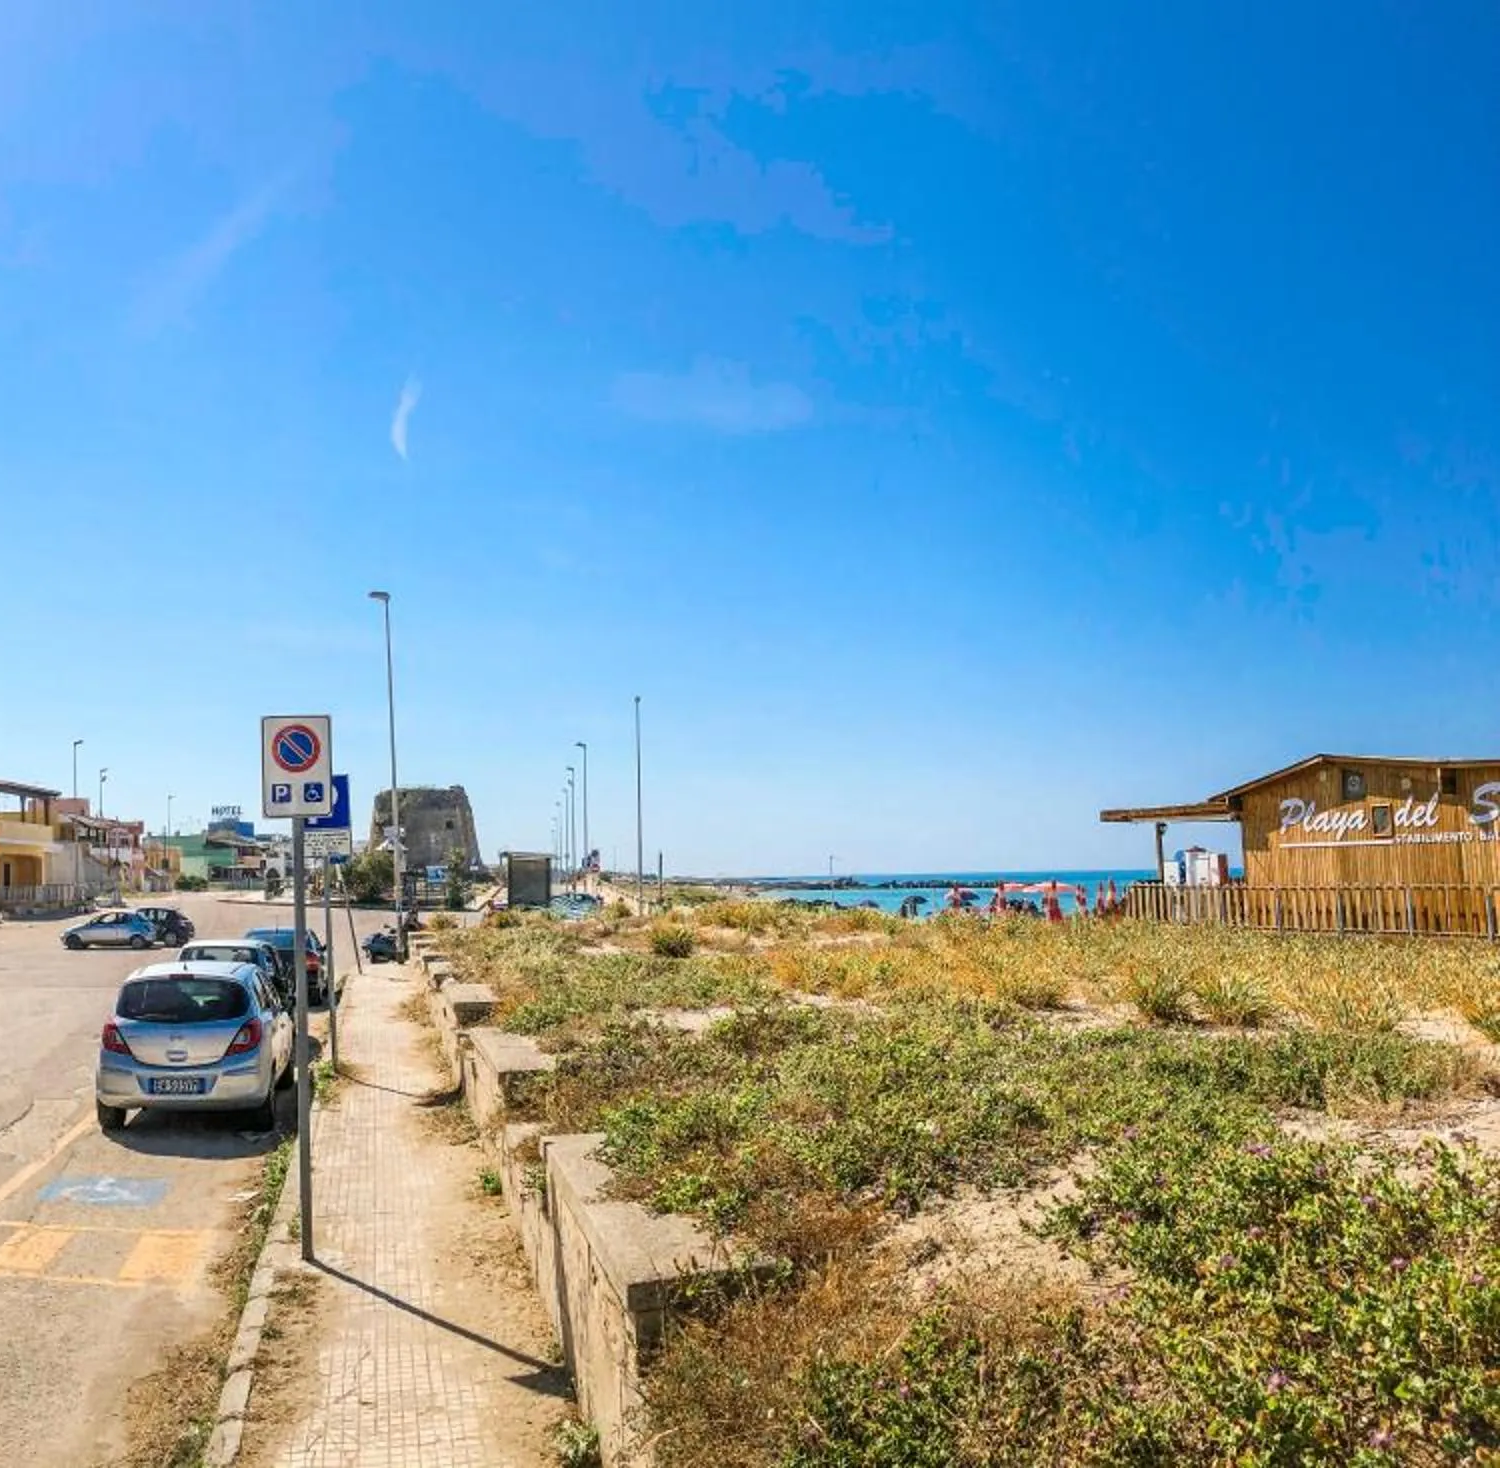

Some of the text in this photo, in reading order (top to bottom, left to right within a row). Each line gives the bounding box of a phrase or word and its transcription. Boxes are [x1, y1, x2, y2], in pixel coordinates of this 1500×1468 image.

[275, 785, 288, 801] P
[211, 805, 243, 816] HOTEL
[1280, 798, 1370, 840] Playa
[1394, 791, 1439, 827] del
[1395, 831, 1473, 844] STABILIMENTO
